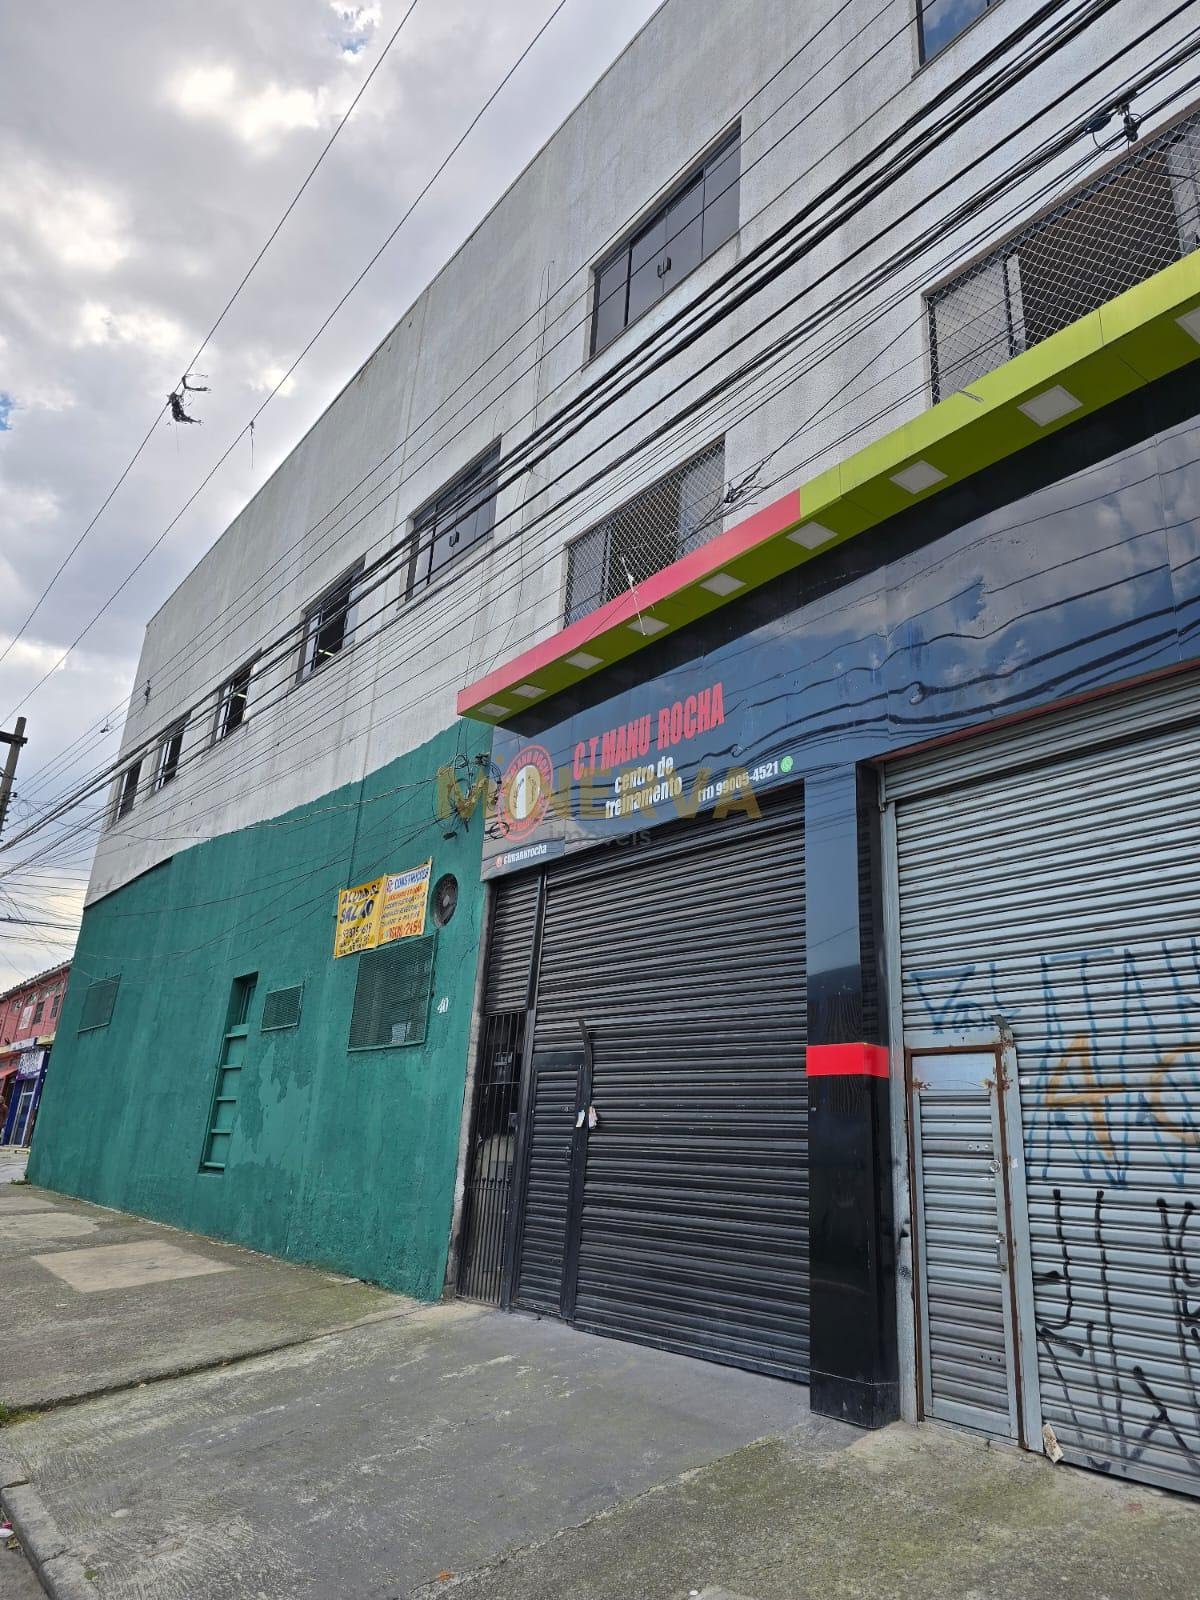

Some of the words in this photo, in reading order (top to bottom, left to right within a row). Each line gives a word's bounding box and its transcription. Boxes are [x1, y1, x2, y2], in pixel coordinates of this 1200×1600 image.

[601, 714, 651, 770] MANU
[657, 681, 725, 751] ROCHA
[605, 776, 683, 819] treinamento
[716, 760, 779, 796] 99005-4521
[614, 762, 655, 794] centro
[656, 755, 674, 778] de
